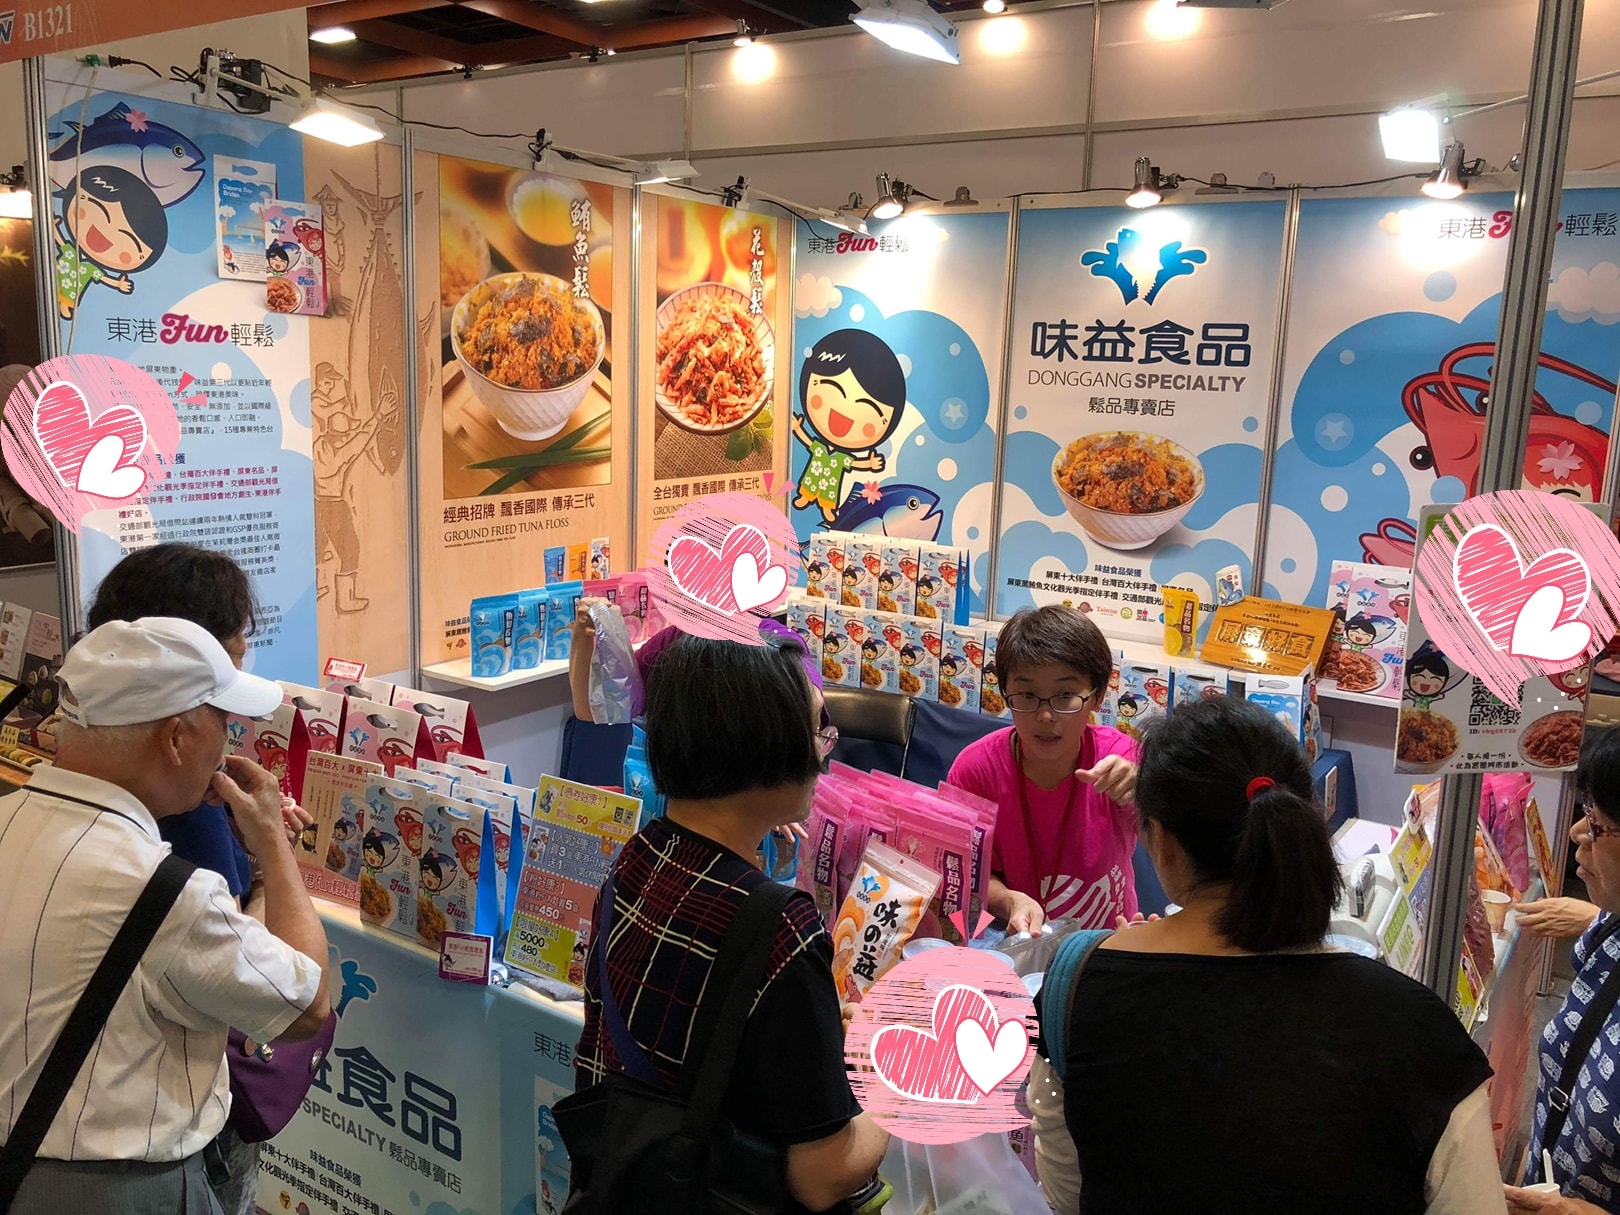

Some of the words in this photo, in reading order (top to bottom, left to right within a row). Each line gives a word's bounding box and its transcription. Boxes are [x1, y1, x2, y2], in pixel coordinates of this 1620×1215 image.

[24, 3, 73, 42] B1321
[570, 200, 591, 299] 鮪魚鬆
[297, 276, 316, 286] Fun
[1030, 318, 1251, 368] 味益食品
[1028, 369, 1133, 389] DONGGANG
[1134, 373, 1247, 393] SPECIALTY
[1088, 396, 1176, 417] 鬆品專賣店
[653, 483, 690, 501] 全台獨賣
[693, 479, 726, 496] 飄香國際
[729, 477, 760, 492] 傳承三代
[443, 502, 496, 525] 經典招牌
[500, 497, 548, 518] 飄香國際
[552, 492, 596, 512] 傳承三代
[444, 527, 489, 543] GROUND
[491, 523, 517, 537] FRIED
[519, 520, 544, 534] TUNA
[545, 516, 570, 530] FLOSS
[1045, 570, 1099, 586] 屏東十大伴手禮
[1101, 577, 1157, 592] 台灣百大伴手禮
[1094, 564, 1142, 578] 味益食品榮獲
[935, 600, 950, 608] Fun
[1096, 606, 1118, 615] Taiwan
[1122, 593, 1164, 607] 交通部觀光
[841, 657, 856, 665] Fun
[880, 663, 895, 672] Fun
[919, 670, 933, 679] Fun
[960, 681, 975, 690] Fun
[309, 756, 340, 771] 台灣百大
[576, 815, 588, 825] 50
[817, 823, 835, 883] 鬆品名物
[389, 878, 411, 895] Fun
[943, 854, 961, 917] 鬆品名物
[446, 901, 468, 920] Fun
[853, 898, 902, 982] 味の益
[533, 1031, 571, 1067] 東港
[302, 1097, 387, 1152] SPECIALTY
[309, 1150, 362, 1188] 味益食品榮獲
[389, 1141, 463, 1195] 鬆品專賣店
[318, 1173, 380, 1215] 台灣百大伴手禮
